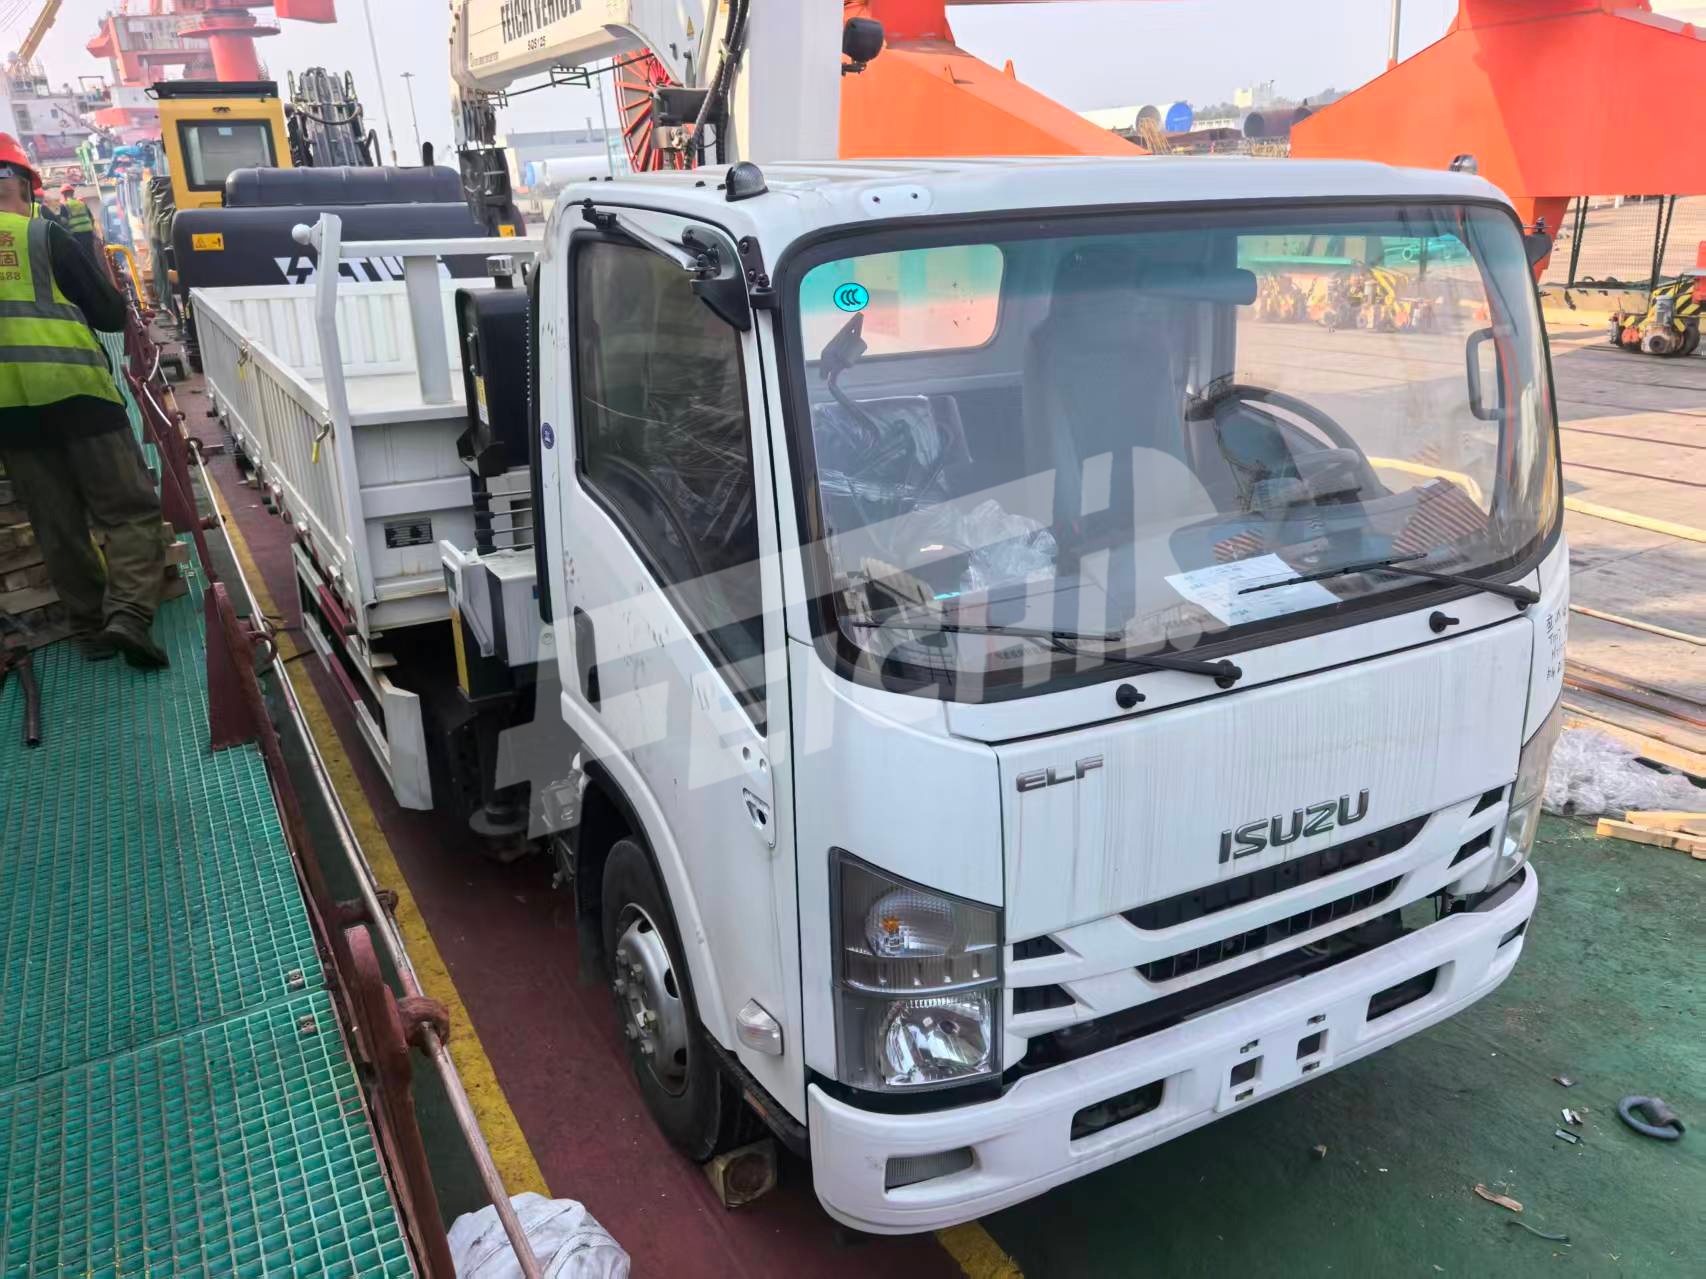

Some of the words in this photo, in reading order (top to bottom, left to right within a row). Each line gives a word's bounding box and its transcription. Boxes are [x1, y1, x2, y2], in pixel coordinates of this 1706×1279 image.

[500, 0, 534, 44] FEICHI
[534, 0, 582, 30] VEHI
[1015, 753, 1104, 793] ELF
[1218, 787, 1370, 865] ISUZU
